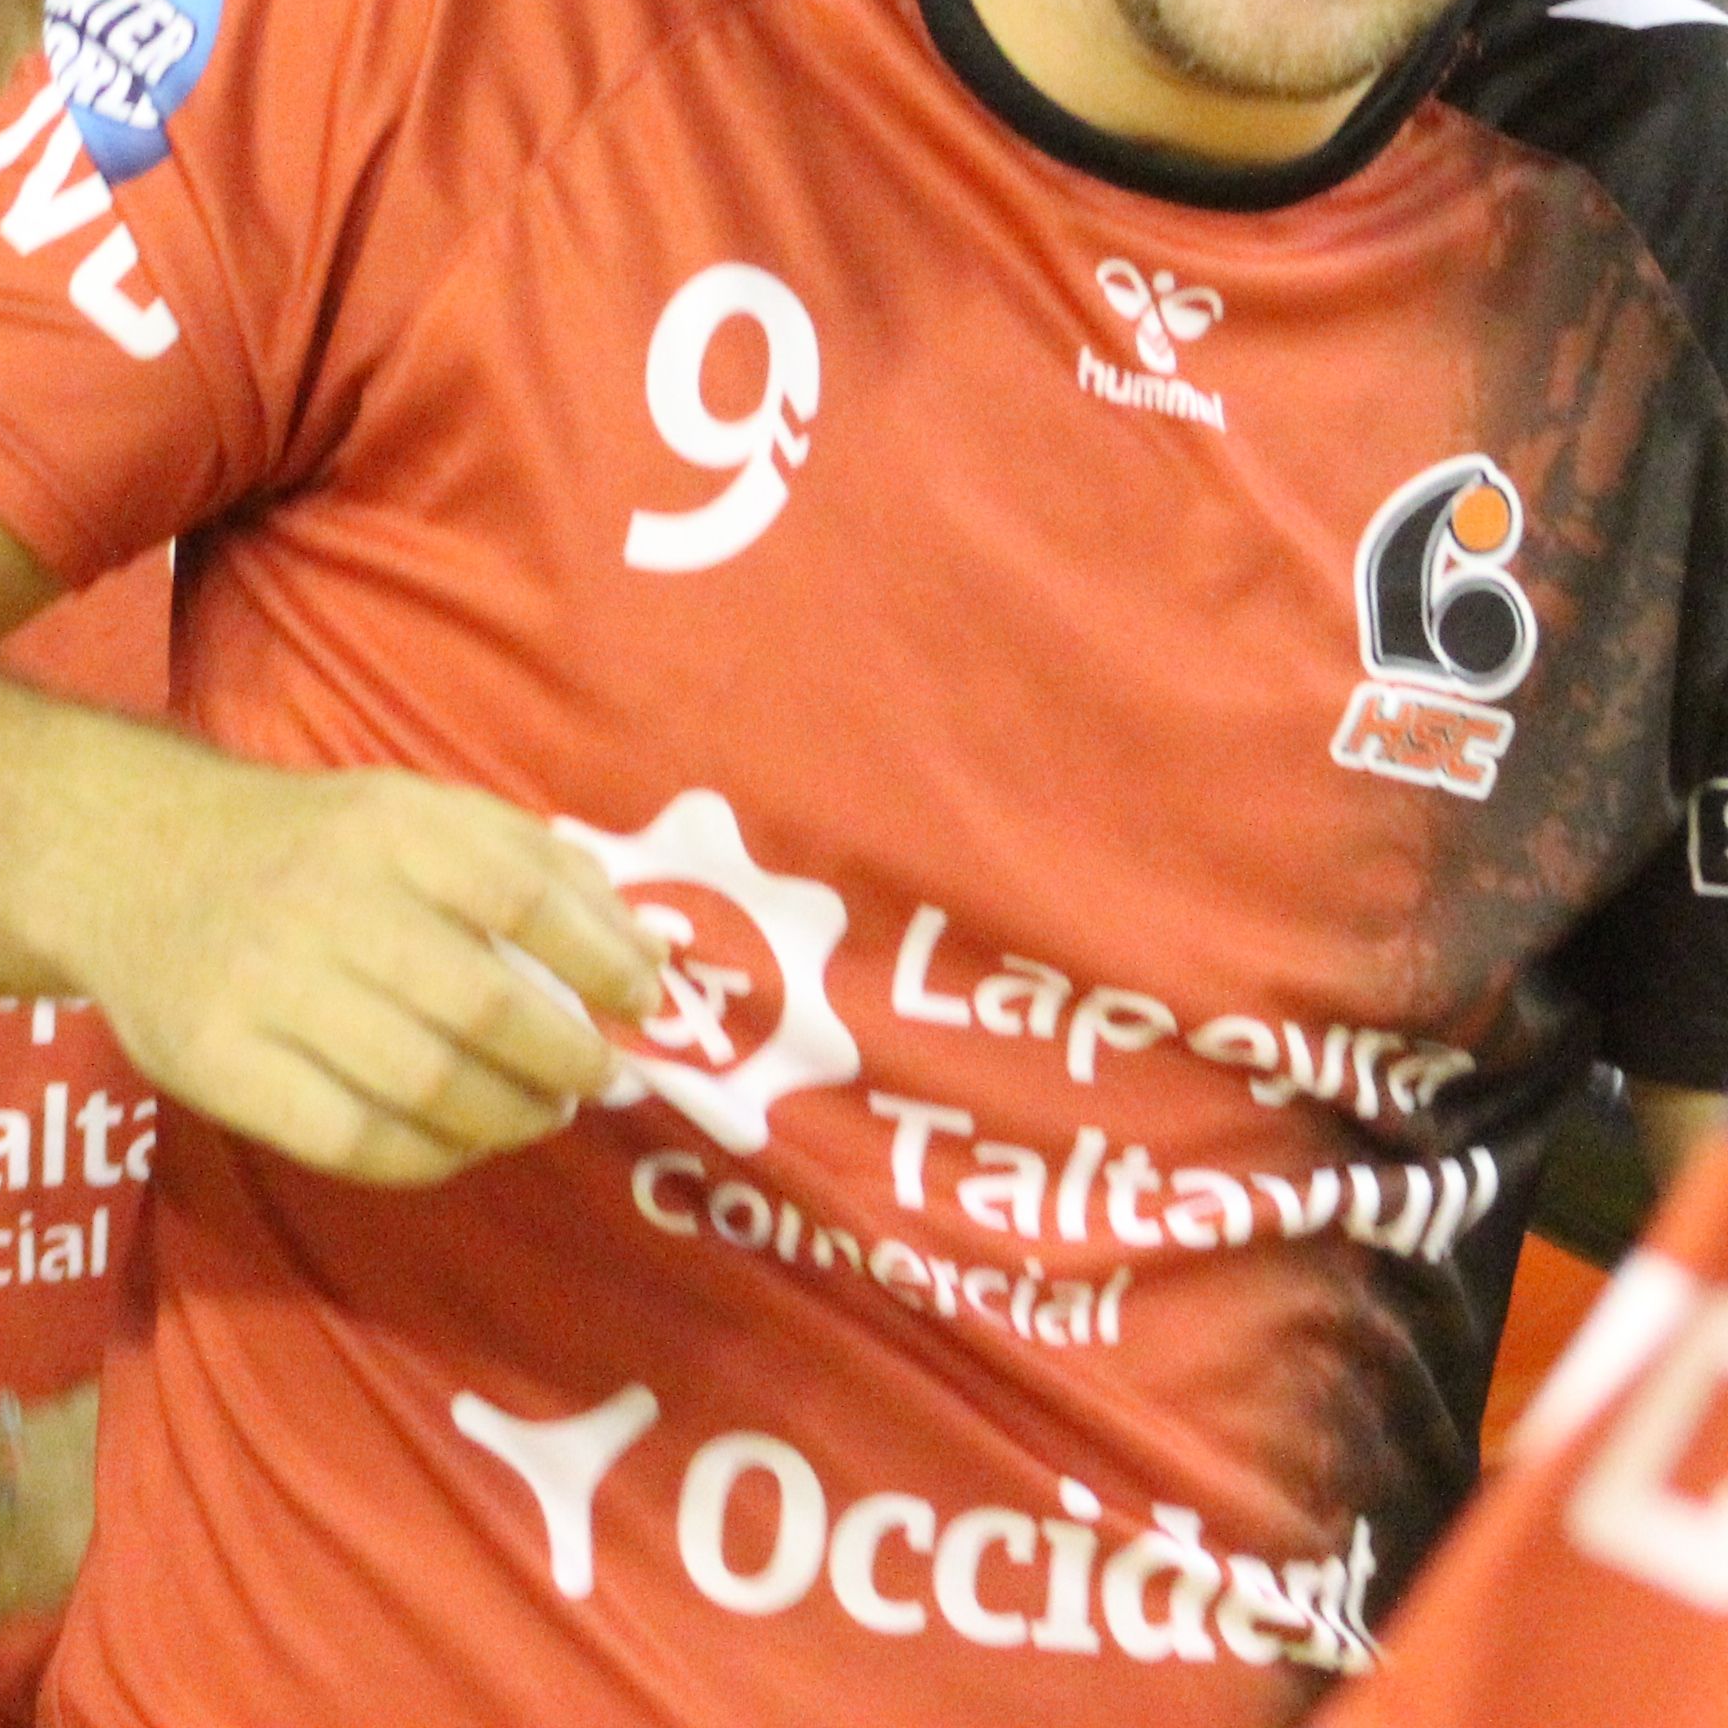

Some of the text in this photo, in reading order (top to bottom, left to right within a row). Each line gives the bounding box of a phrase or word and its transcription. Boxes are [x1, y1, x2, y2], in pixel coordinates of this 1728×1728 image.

[622, 260, 822, 572] 9
[1077, 343, 1227, 435] hummel
[1340, 689, 1510, 793] HSC
[891, 903, 1477, 1120] Lapeyra
[630, 1149, 1132, 1347] Comercial
[868, 1088, 1499, 1264] Taltavull
[676, 1429, 1380, 1674] Occident
